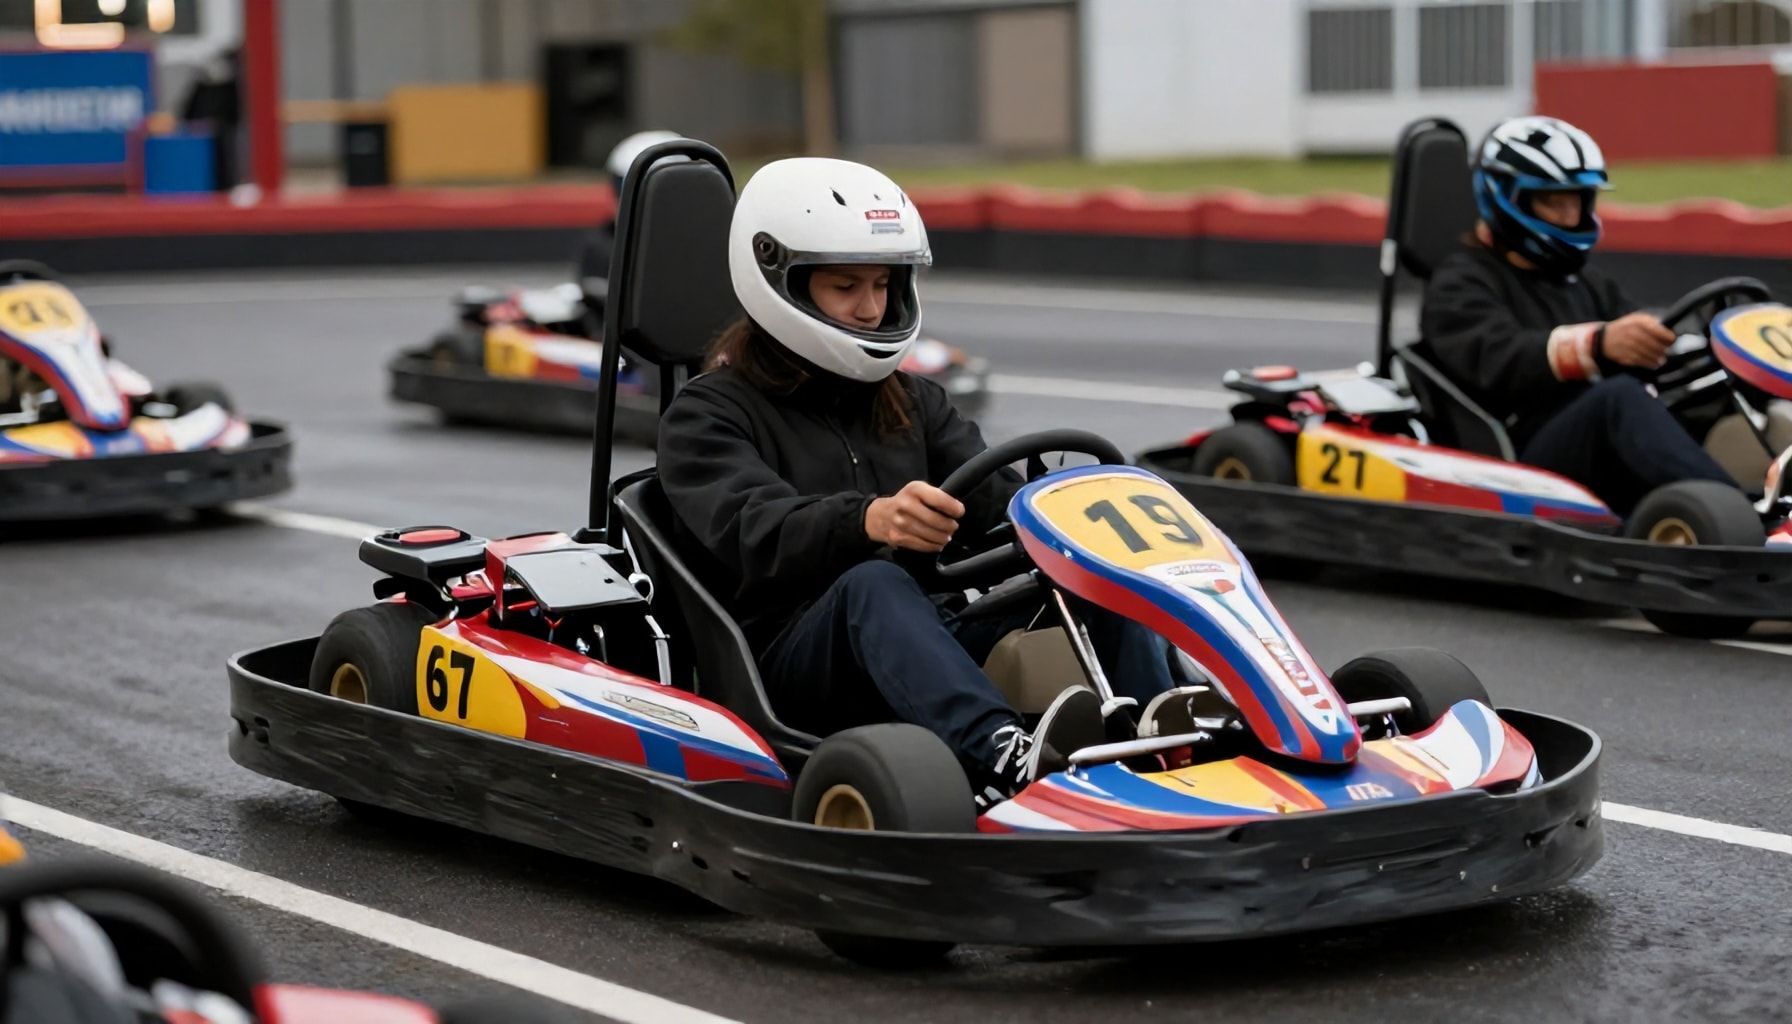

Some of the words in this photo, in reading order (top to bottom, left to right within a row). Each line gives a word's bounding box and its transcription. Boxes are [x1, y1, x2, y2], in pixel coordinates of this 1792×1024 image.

[1321, 443, 1366, 491] 27
[1084, 495, 1203, 553] 19
[426, 645, 475, 719] 67
